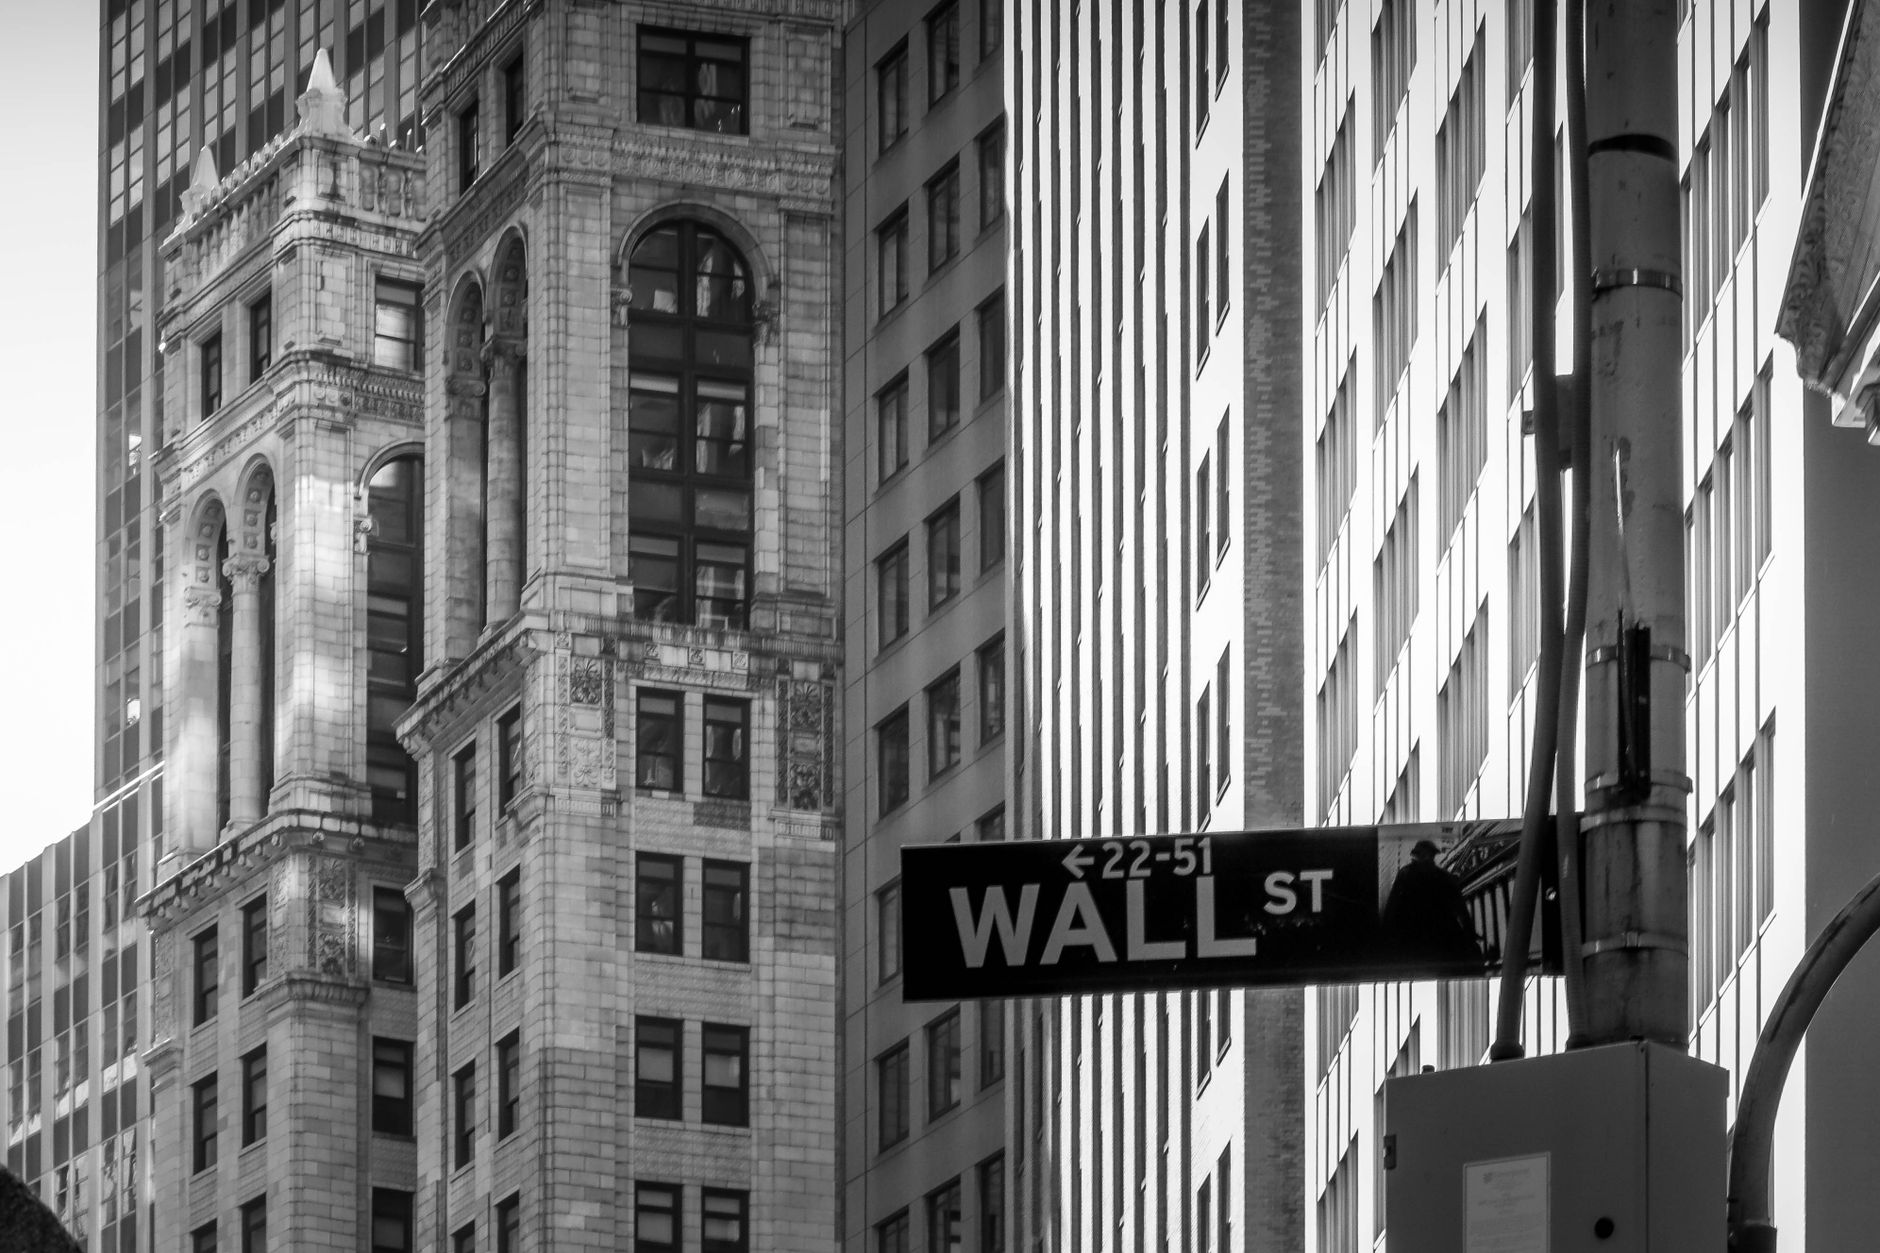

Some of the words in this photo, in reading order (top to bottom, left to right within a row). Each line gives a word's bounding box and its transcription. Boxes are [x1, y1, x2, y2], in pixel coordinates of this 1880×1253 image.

[1101, 838, 1213, 879] 22-51
[949, 877, 1257, 968] WALL
[1263, 869, 1334, 915] ST
